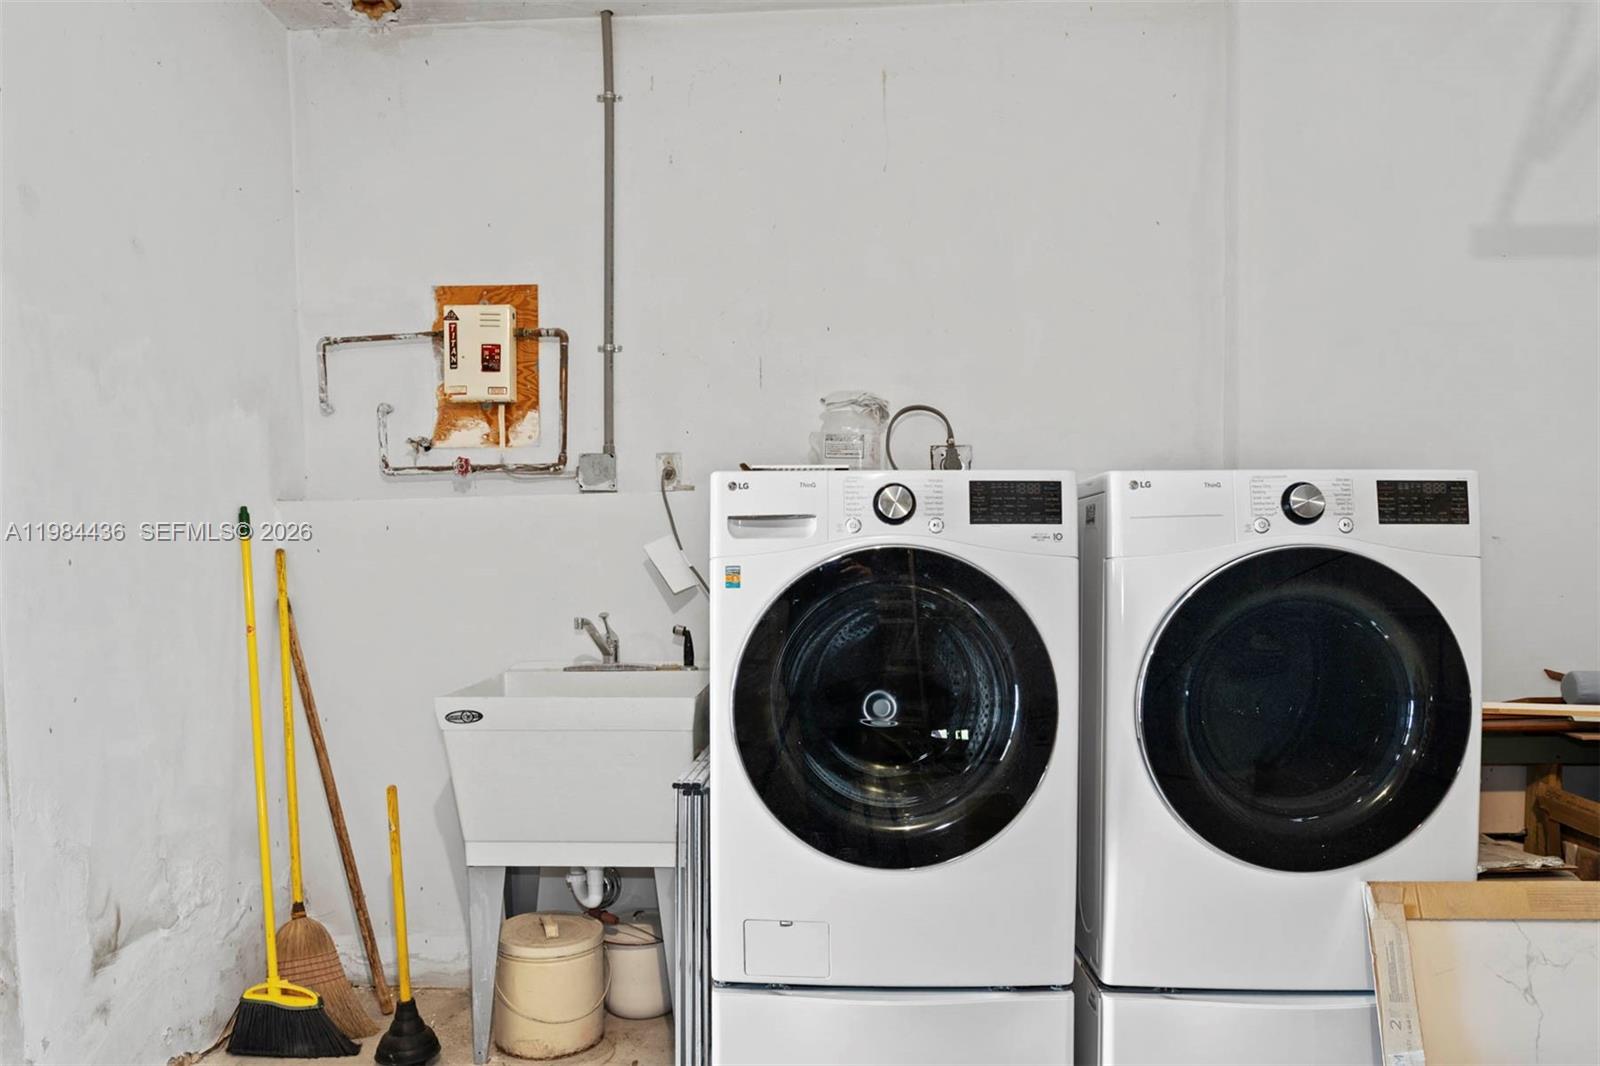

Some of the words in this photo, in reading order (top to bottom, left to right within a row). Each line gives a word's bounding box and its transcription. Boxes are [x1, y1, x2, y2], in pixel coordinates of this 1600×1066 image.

[449, 324, 457, 363] TITAN
[738, 482, 749, 490] LG
[1139, 480, 1152, 489] LG
[1203, 481, 1222, 489] ThinQ
